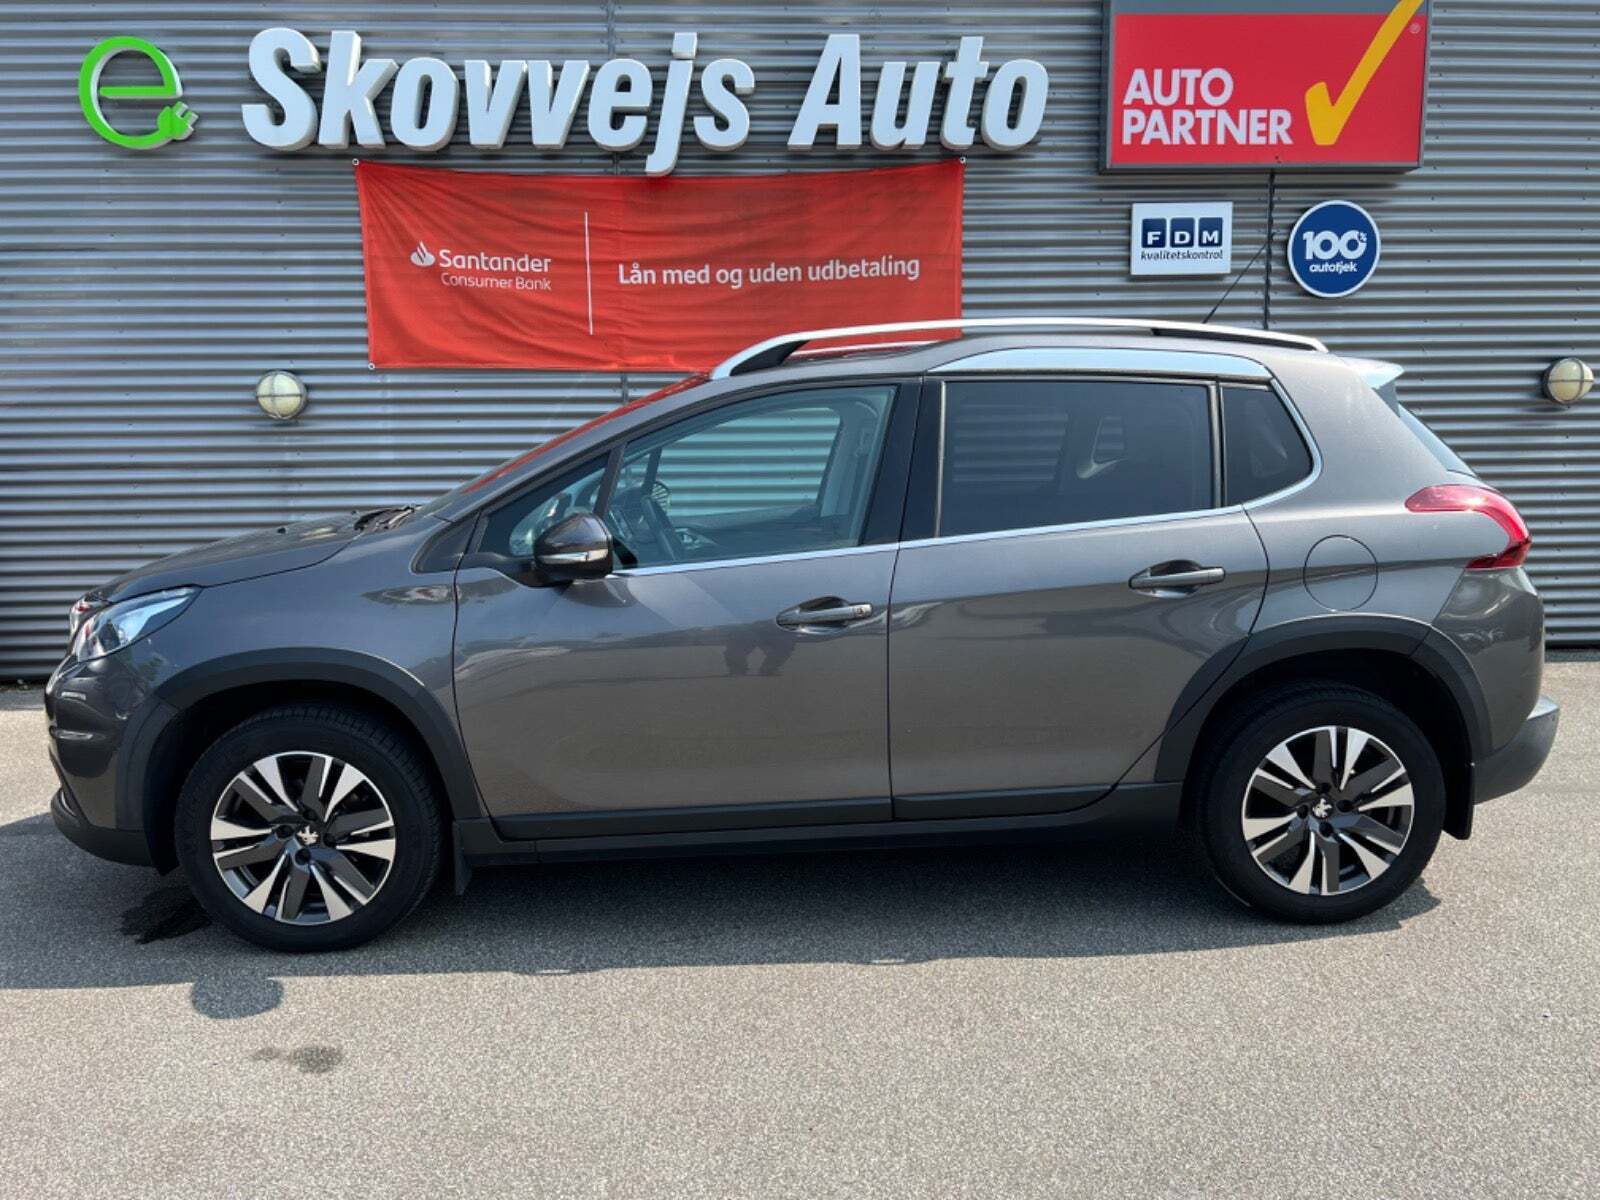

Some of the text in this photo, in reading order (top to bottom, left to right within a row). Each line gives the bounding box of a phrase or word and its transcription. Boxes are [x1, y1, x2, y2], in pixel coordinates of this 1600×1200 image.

[242, 28, 1049, 176] Skovvejs Auto
[1123, 67, 1234, 106] AUTO
[1122, 109, 1294, 146] PARTNER
[438, 249, 552, 273] Santander
[618, 254, 921, 290] Lån med og uden udbetaling
[1141, 249, 1224, 262] kvalitetskontrol
[440, 272, 552, 291] Consumer Bank
